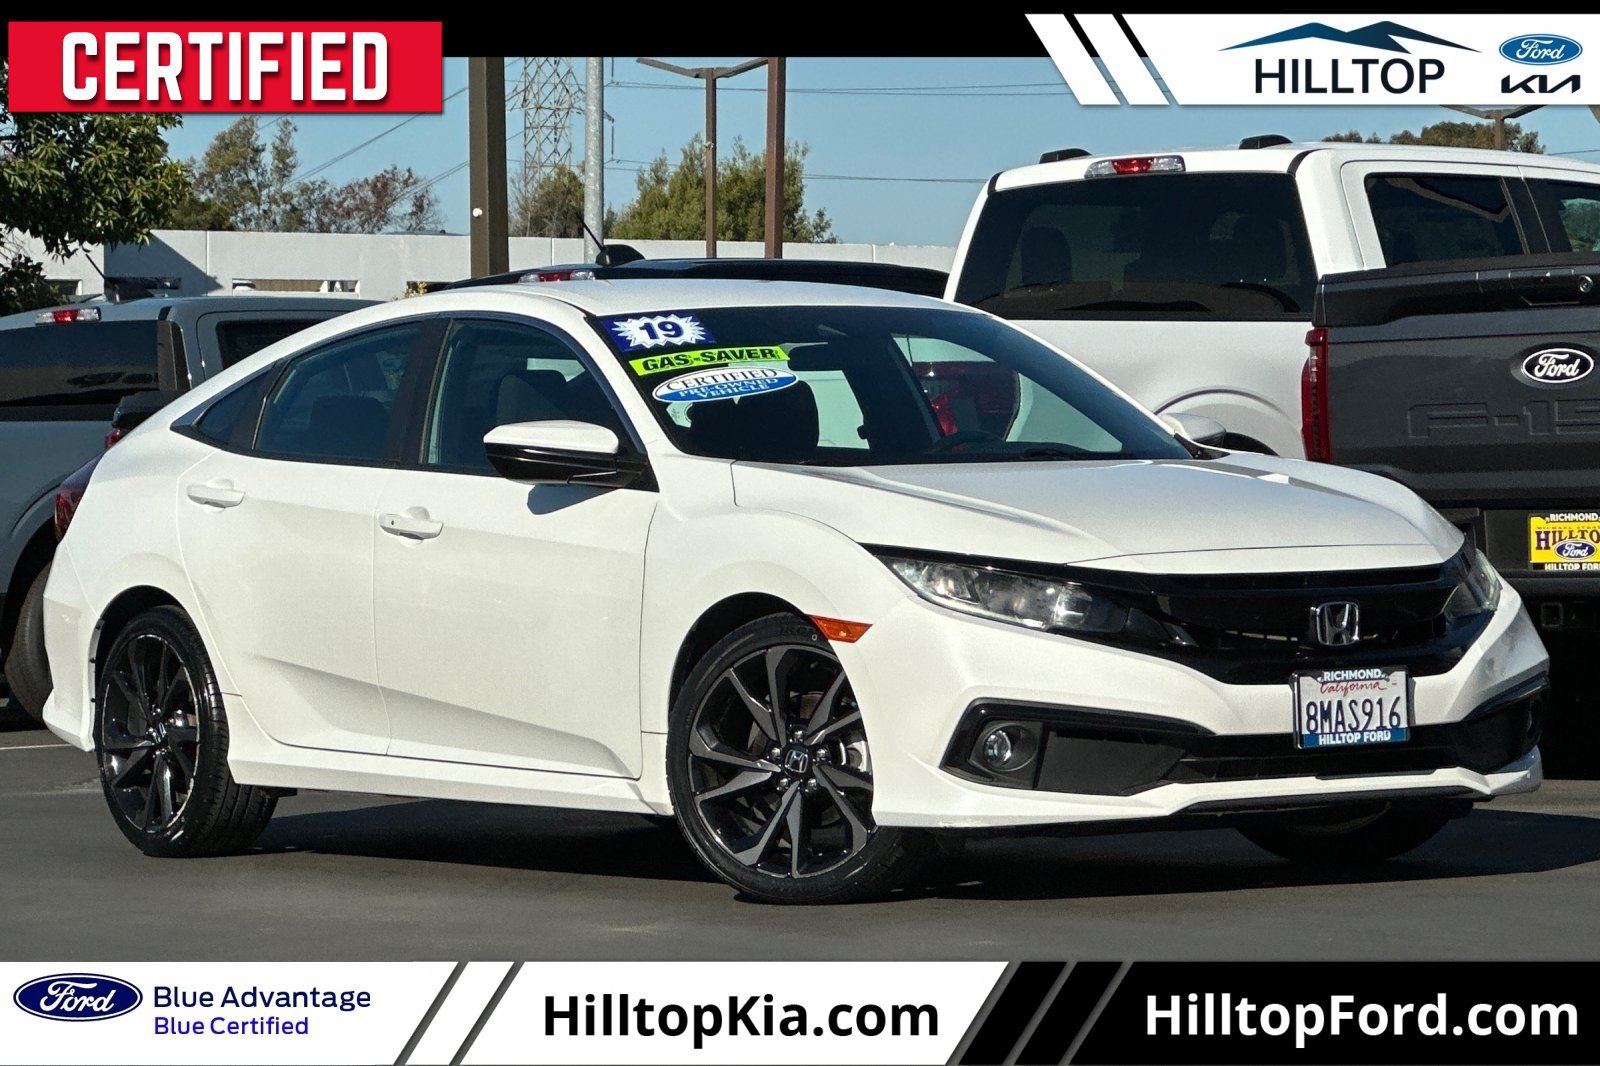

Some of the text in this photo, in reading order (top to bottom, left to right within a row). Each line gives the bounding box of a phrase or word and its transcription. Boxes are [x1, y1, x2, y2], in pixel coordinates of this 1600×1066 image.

[639, 321, 684, 340] 19
[642, 348, 779, 371] GAS-SAVER
[1534, 353, 1581, 378] Ford
[666, 368, 778, 391] CERTIFIED
[679, 378, 778, 397] PRE-OWNED
[697, 385, 771, 399] VEHICLE
[1550, 513, 1599, 522] RICHMOND
[1562, 542, 1589, 557] Ford
[1544, 563, 1580, 571] HILLTOP
[1323, 668, 1382, 682] RICHMOND
[1319, 681, 1387, 697] California
[1306, 696, 1401, 733] 8MAS916
[1318, 730, 1392, 745] HILLTOP FORD
